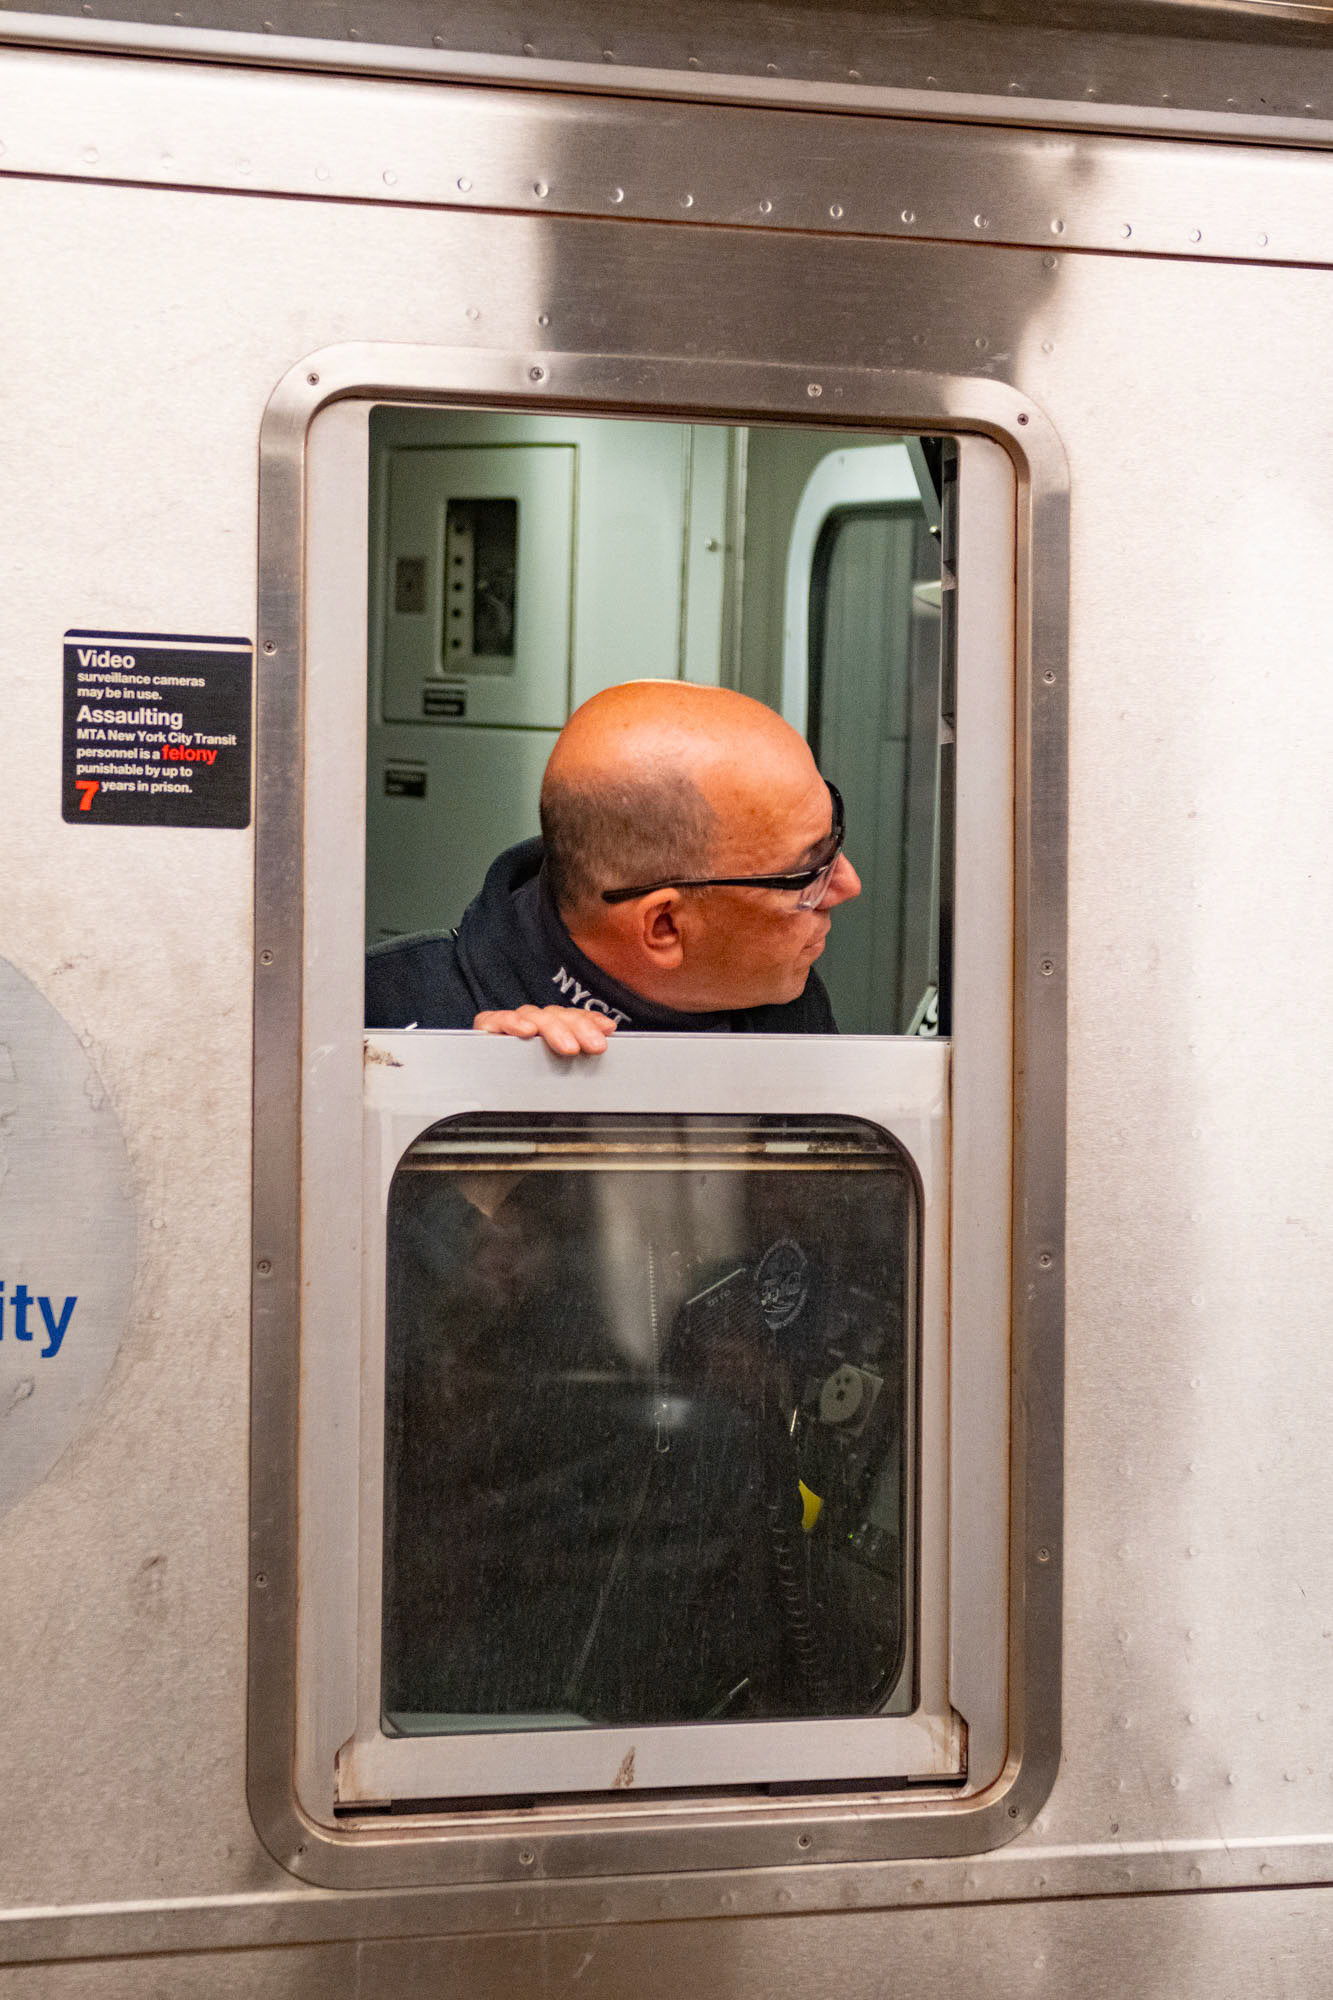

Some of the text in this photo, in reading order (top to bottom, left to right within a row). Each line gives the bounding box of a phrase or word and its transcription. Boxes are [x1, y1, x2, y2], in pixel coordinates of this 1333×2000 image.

[78, 649, 135, 668] Video
[78, 672, 205, 687] surveillance cameras
[77, 688, 162, 700] may be in use.
[77, 705, 183, 730] Assaulting
[77, 729, 237, 745] MTA New York City Transit
[77, 744, 218, 765] personnel is a felony
[76, 764, 192, 778] punishable by up to
[75, 780, 192, 811] 7 years in prison.
